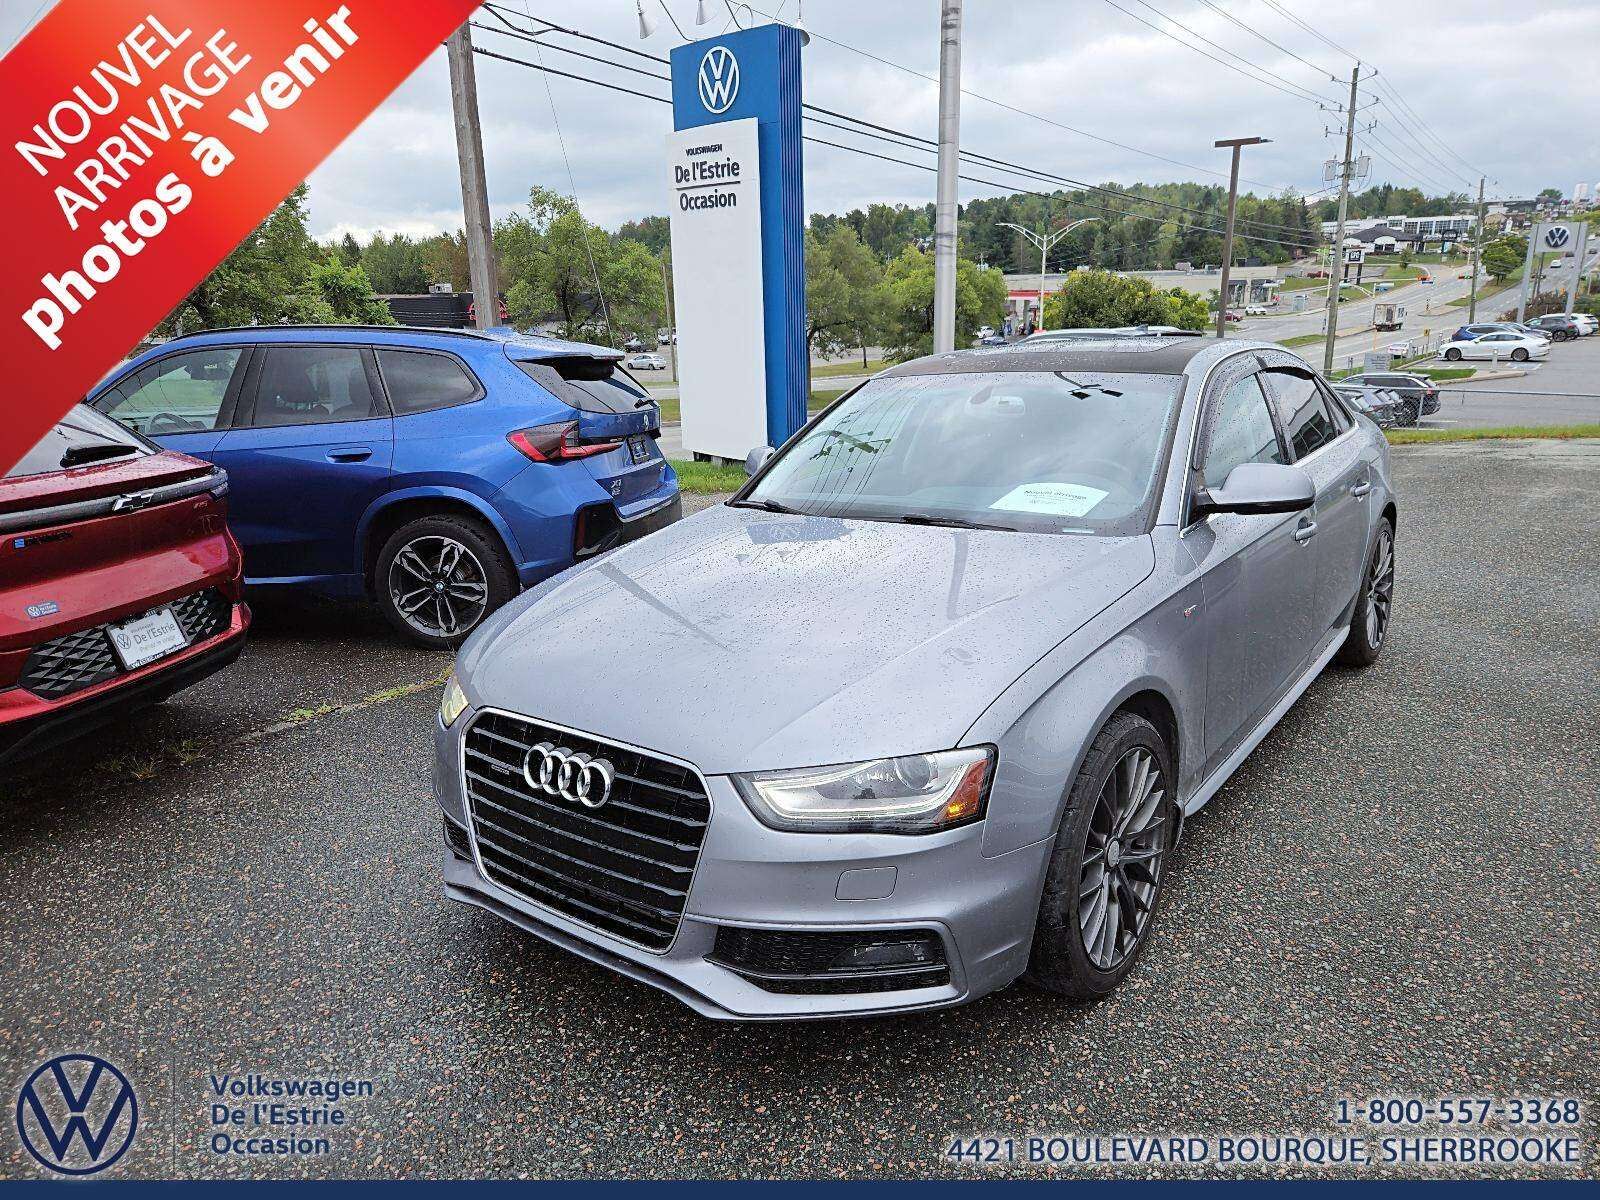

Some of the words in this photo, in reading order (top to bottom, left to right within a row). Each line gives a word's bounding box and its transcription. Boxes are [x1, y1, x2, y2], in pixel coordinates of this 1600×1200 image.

[685, 144, 723, 157] VOLKSWAGEN
[674, 165, 690, 184] De
[692, 157, 740, 181] l'Estrie
[679, 189, 737, 211] Occasion
[134, 632, 148, 645] De
